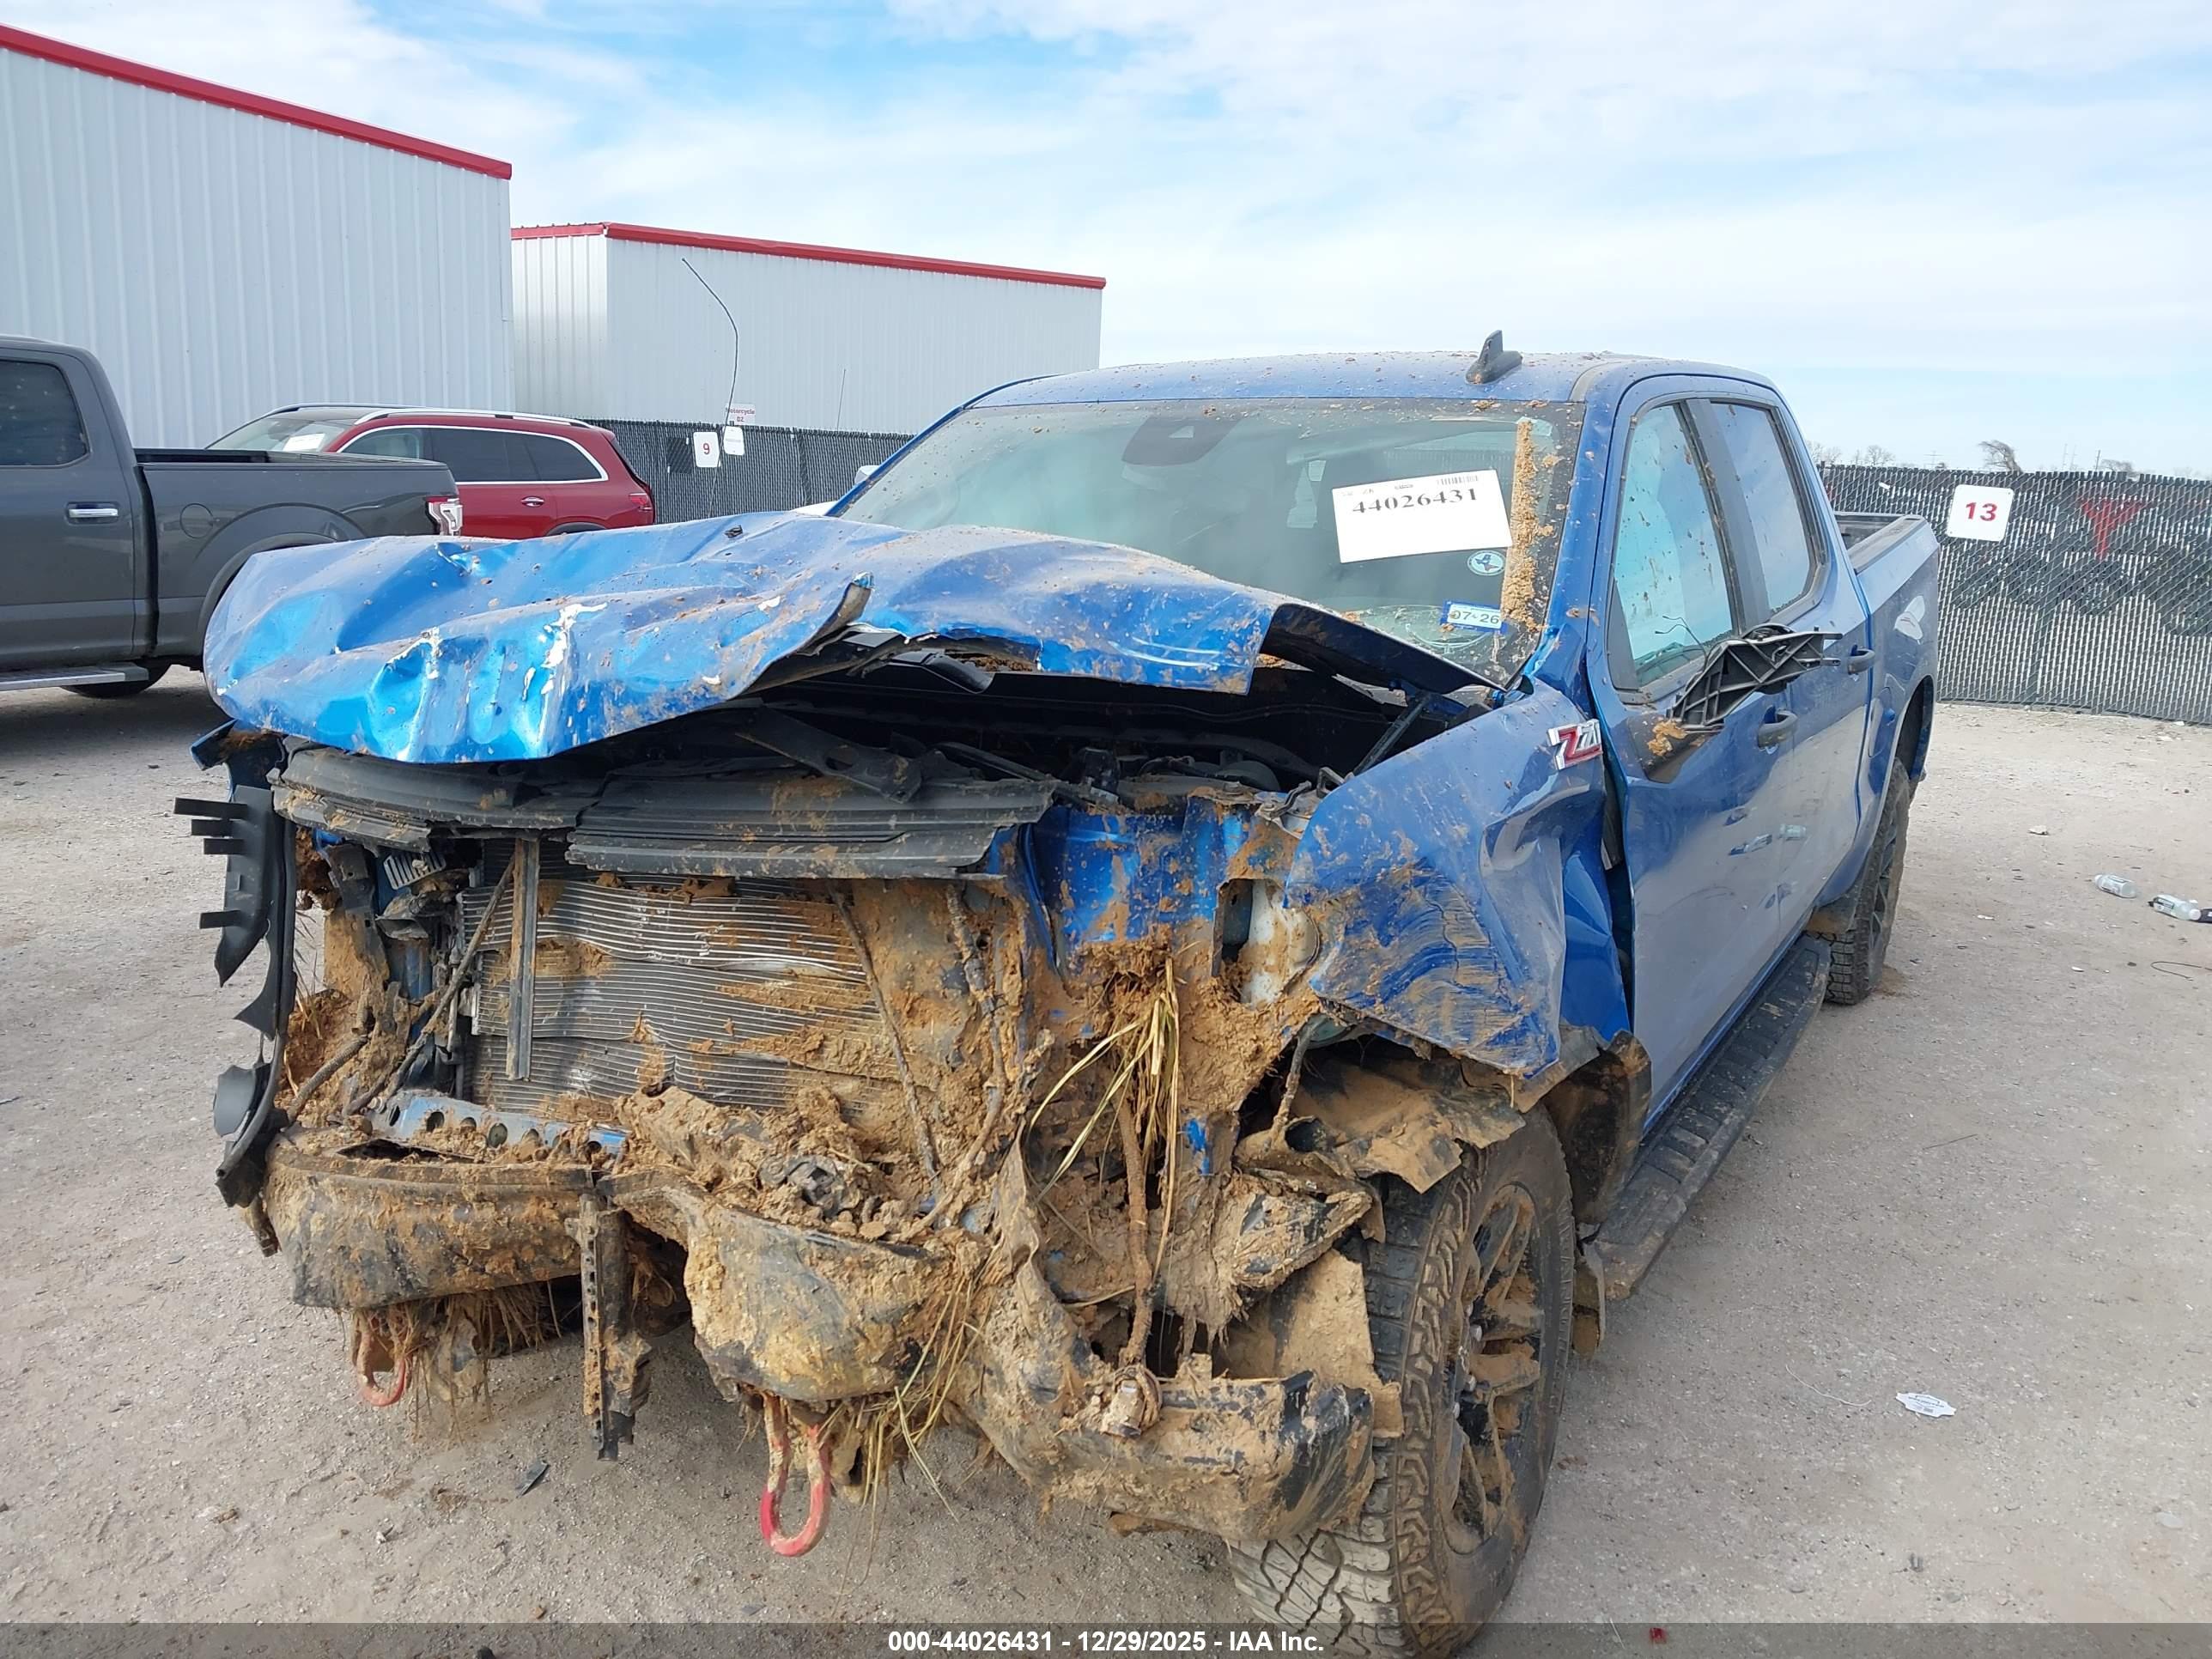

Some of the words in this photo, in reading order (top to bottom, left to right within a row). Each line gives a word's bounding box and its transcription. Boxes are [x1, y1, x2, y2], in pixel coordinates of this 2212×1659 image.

[702, 442, 710, 454] 9
[1352, 488, 1477, 514] 44026431
[1965, 501, 1998, 522] 13
